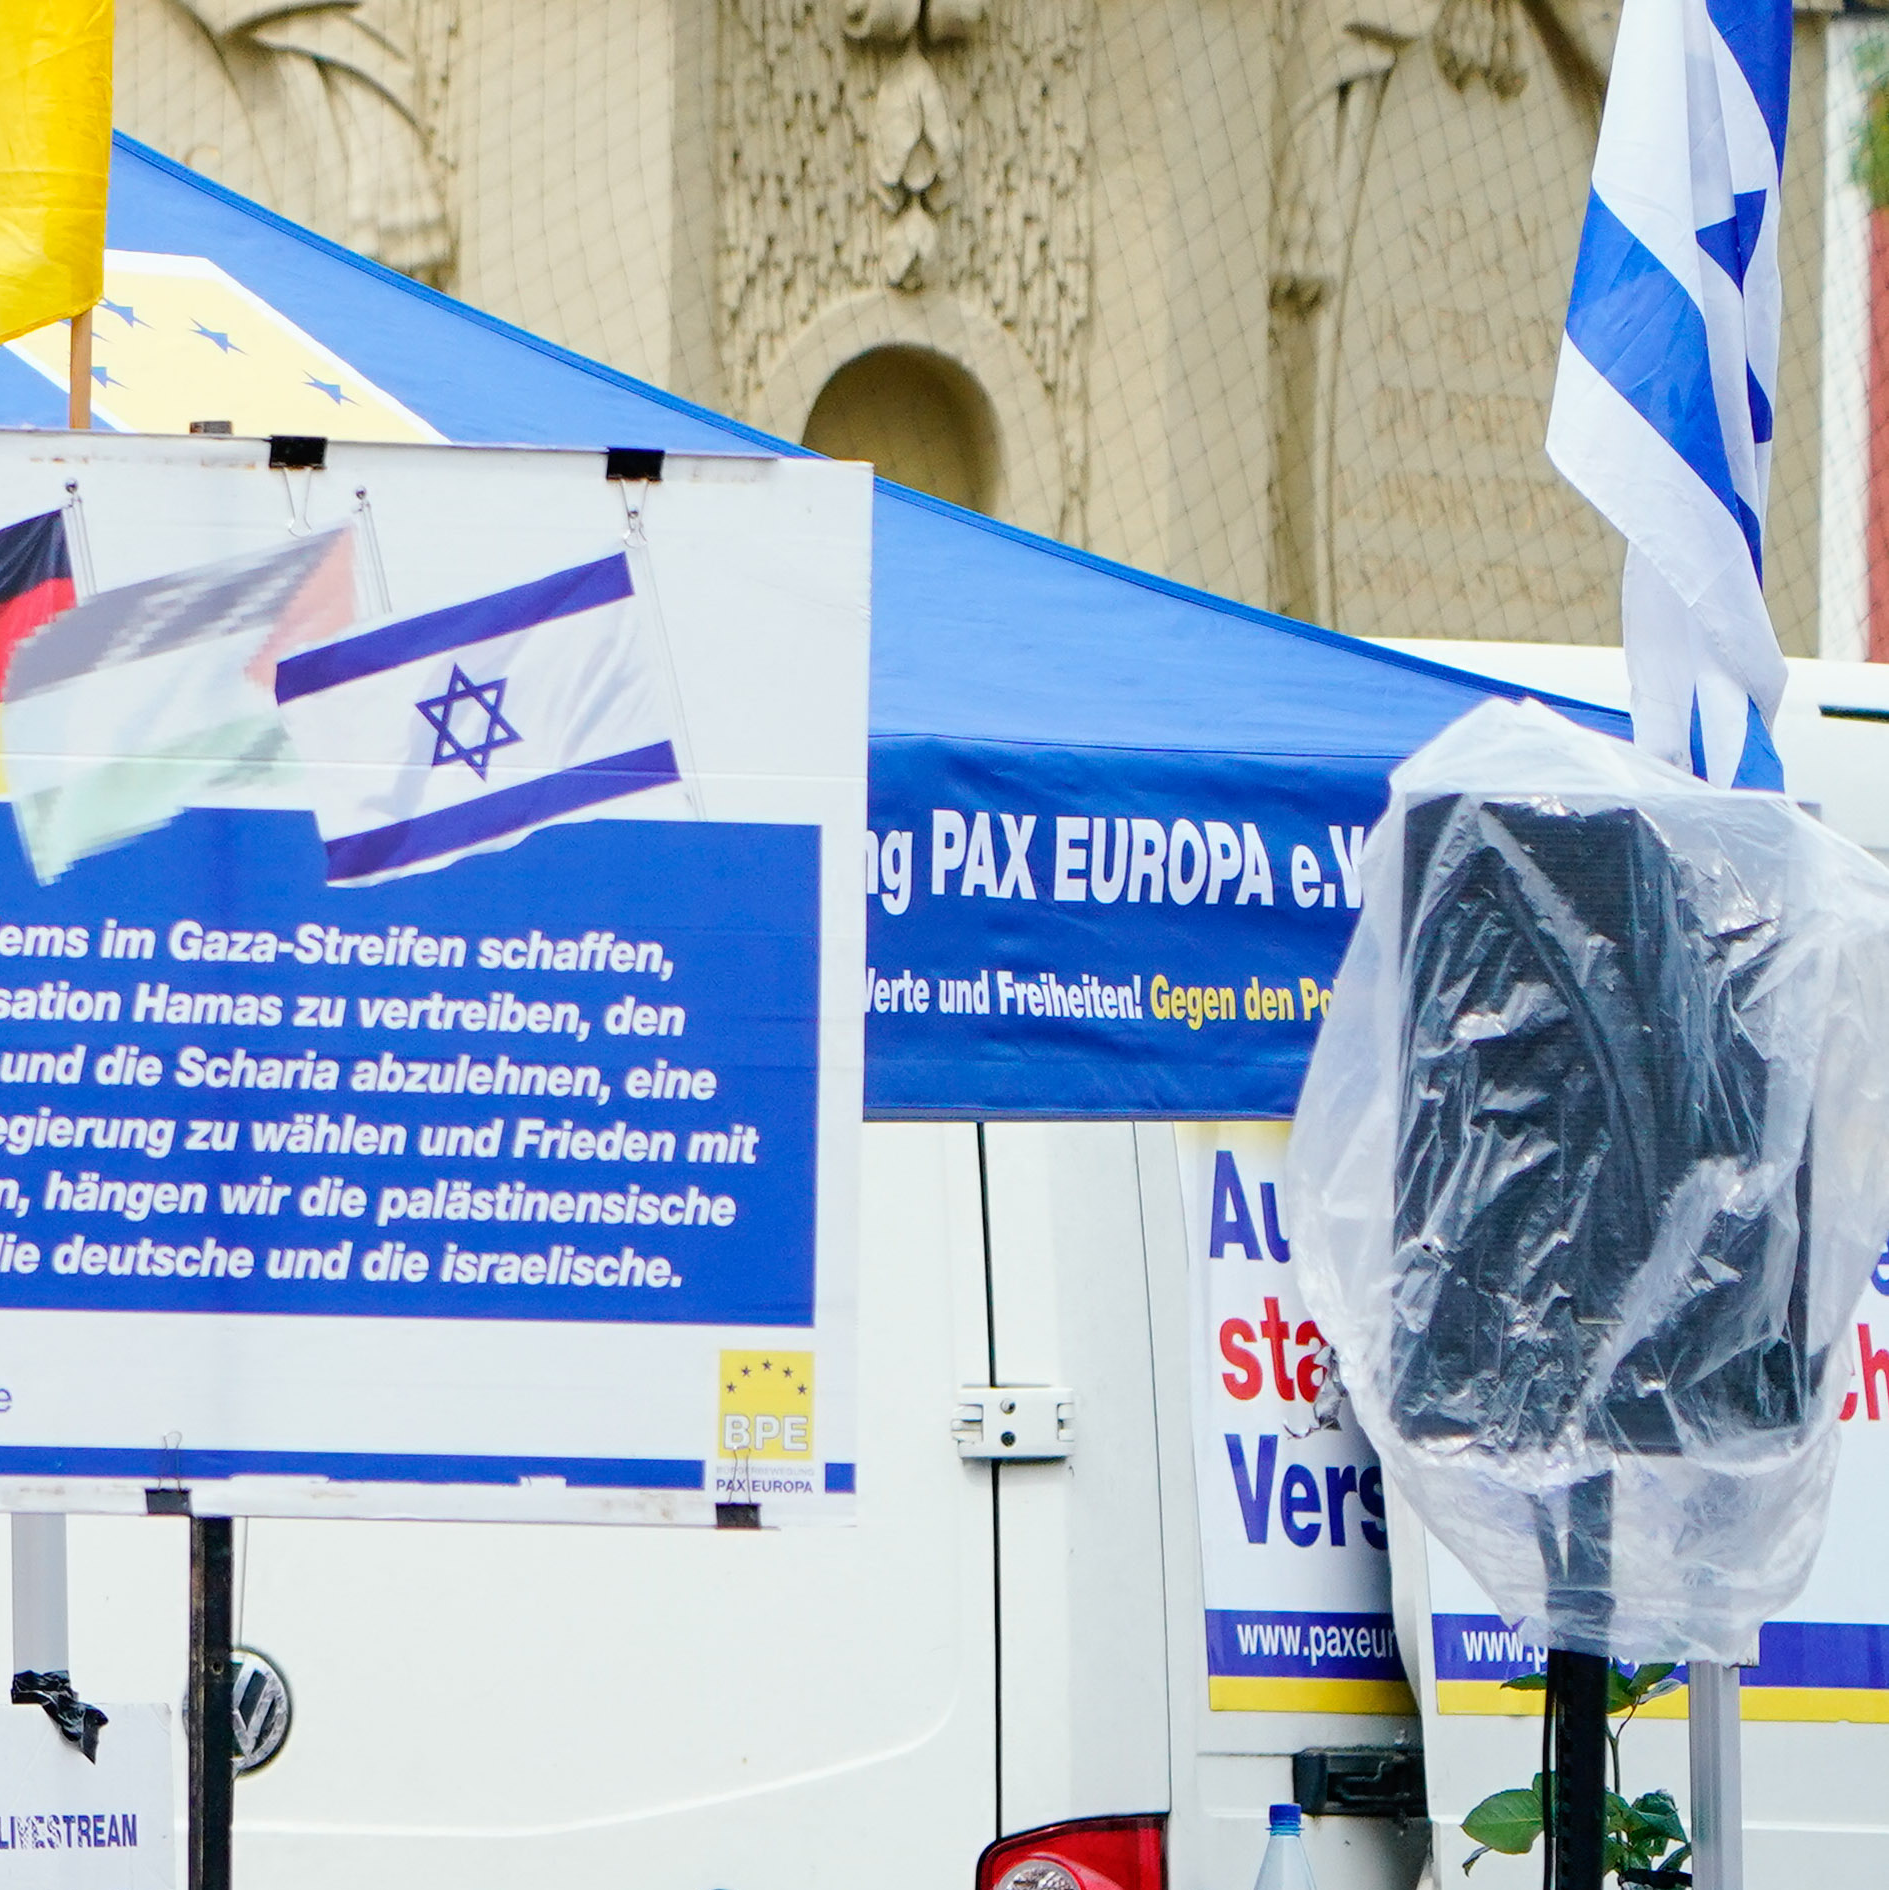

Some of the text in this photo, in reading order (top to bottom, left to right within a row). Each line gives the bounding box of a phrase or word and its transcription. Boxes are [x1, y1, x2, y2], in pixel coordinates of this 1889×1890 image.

[930, 809, 1038, 901] PAX
[1053, 816, 1275, 906] EUROPA
[101, 920, 155, 960] im
[168, 920, 466, 968] Gaza-Streifen
[477, 930, 675, 980] schaffen,
[131, 982, 283, 1026] Hamas
[293, 995, 346, 1027] zu
[358, 992, 591, 1041] vertreiben,
[604, 996, 686, 1036] den
[938, 970, 990, 1016] und
[996, 971, 1143, 1020] Freiheiten!
[1149, 974, 1238, 1032] Gegen
[1244, 977, 1296, 1022] den
[94, 1045, 163, 1087] die
[175, 1047, 340, 1090] Scharia
[351, 1052, 611, 1105] abzulehnen,
[625, 1059, 717, 1100] eine
[184, 1118, 237, 1152] zu
[252, 1114, 407, 1156] wählen
[419, 1118, 504, 1158] und
[513, 1119, 677, 1163] Frieden
[687, 1124, 760, 1164] mit
[44, 1171, 207, 1222] hängen
[220, 1176, 291, 1215] wir
[300, 1177, 367, 1218] die
[376, 1180, 737, 1227] palästinensische
[52, 1235, 254, 1280] deutsche
[266, 1240, 352, 1280] und
[361, 1241, 429, 1282] die
[440, 1243, 683, 1288] israelische.
[723, 1413, 808, 1451] BPE
[716, 1479, 814, 1493] PAX EUROPA
[1224, 1433, 1388, 1549] Vers
